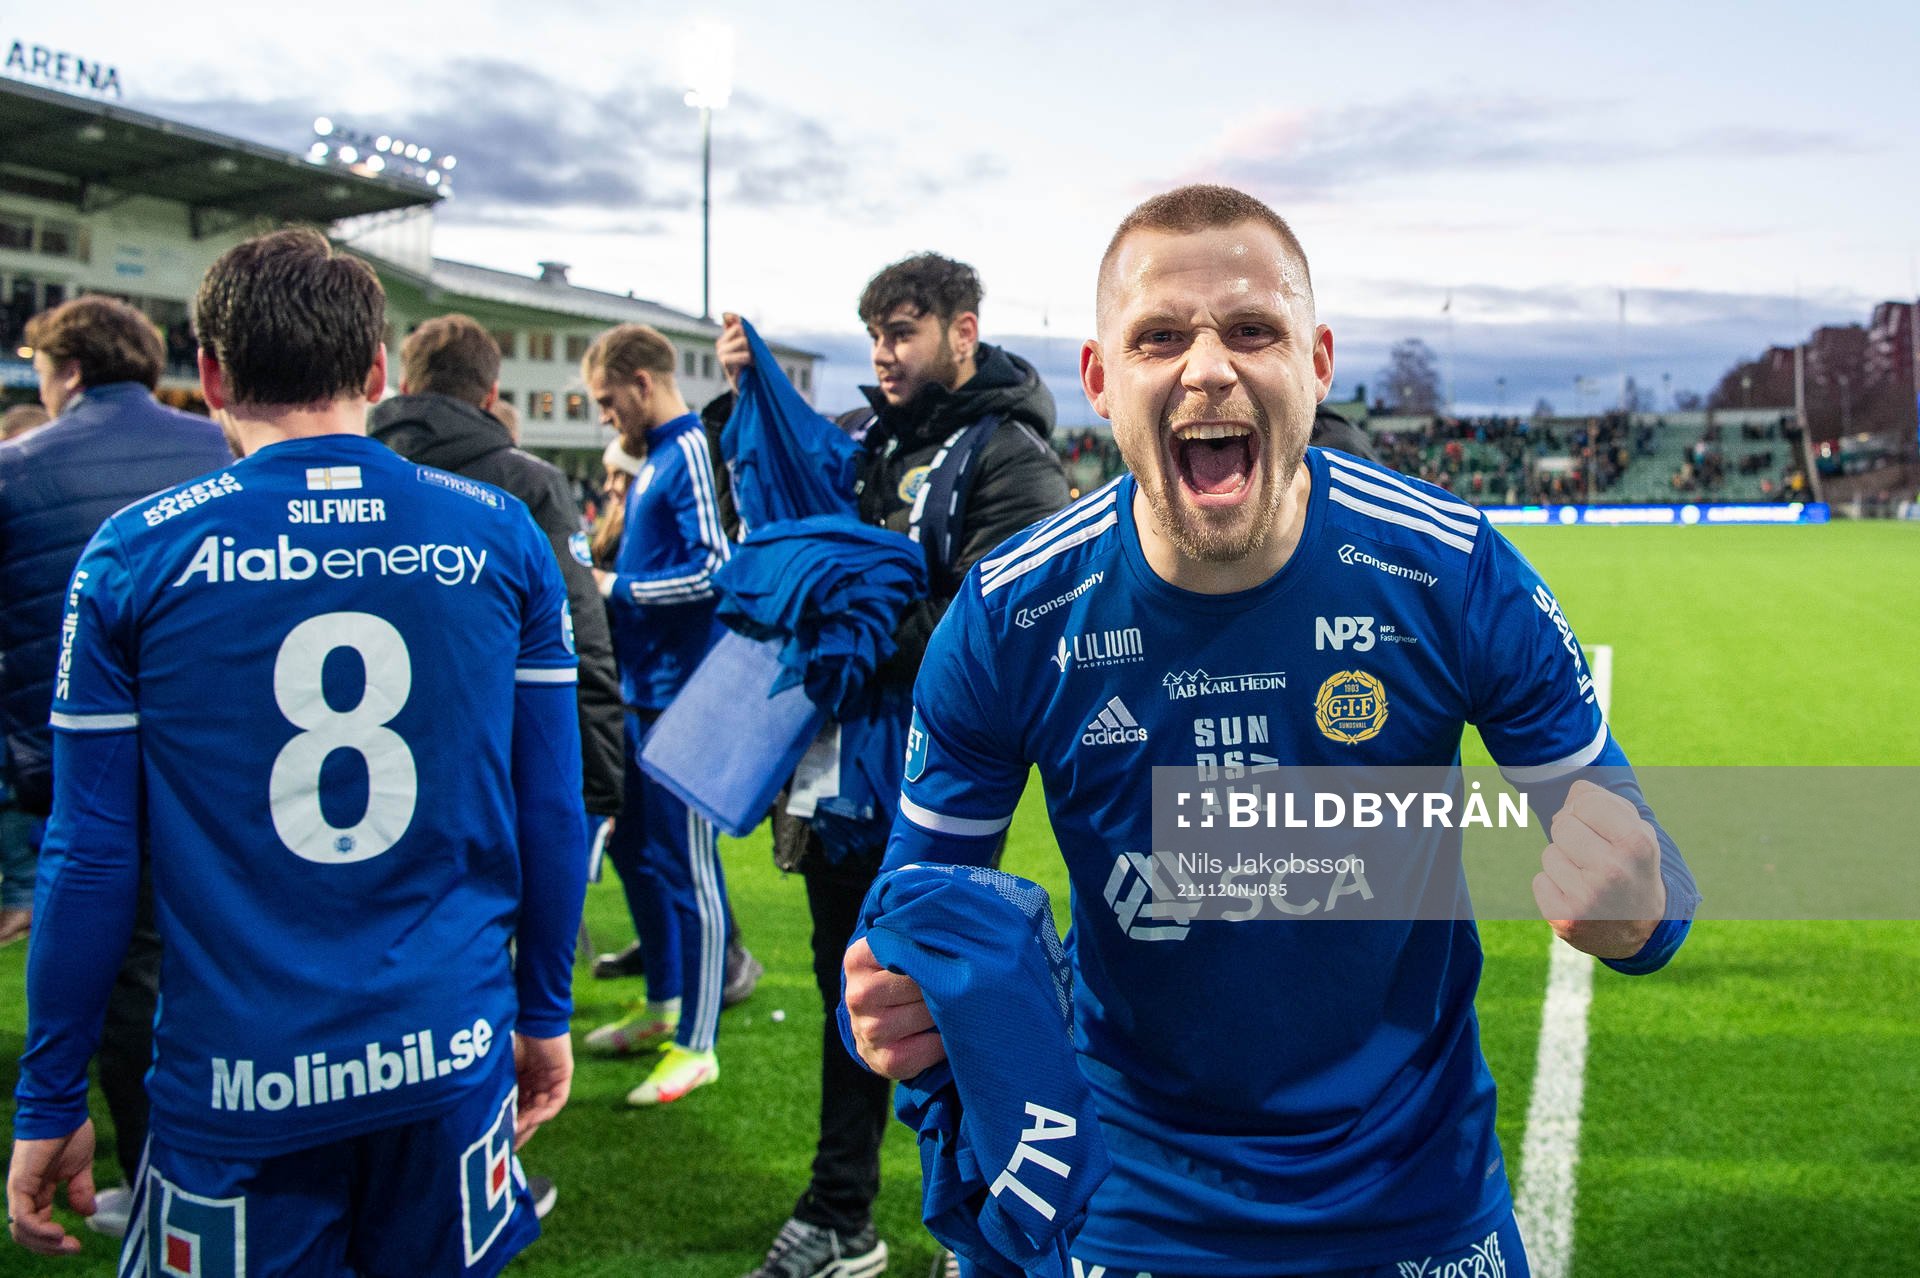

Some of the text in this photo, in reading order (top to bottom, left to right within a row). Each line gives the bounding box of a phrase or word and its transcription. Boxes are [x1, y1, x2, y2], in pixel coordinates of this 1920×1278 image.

[6, 39, 122, 97] ARENA
[288, 499, 386, 524] SILFWER
[1353, 550, 1438, 588] consembly
[1030, 570, 1104, 619] consembly
[1074, 628, 1143, 662] LILIUM
[1315, 616, 1376, 652] NP3
[1380, 625, 1395, 633] NP3
[269, 611, 418, 864] 8
[1082, 726, 1148, 745] adidas
[1194, 715, 1269, 747] SUN
[212, 1018, 493, 1112] Molinbil.se
